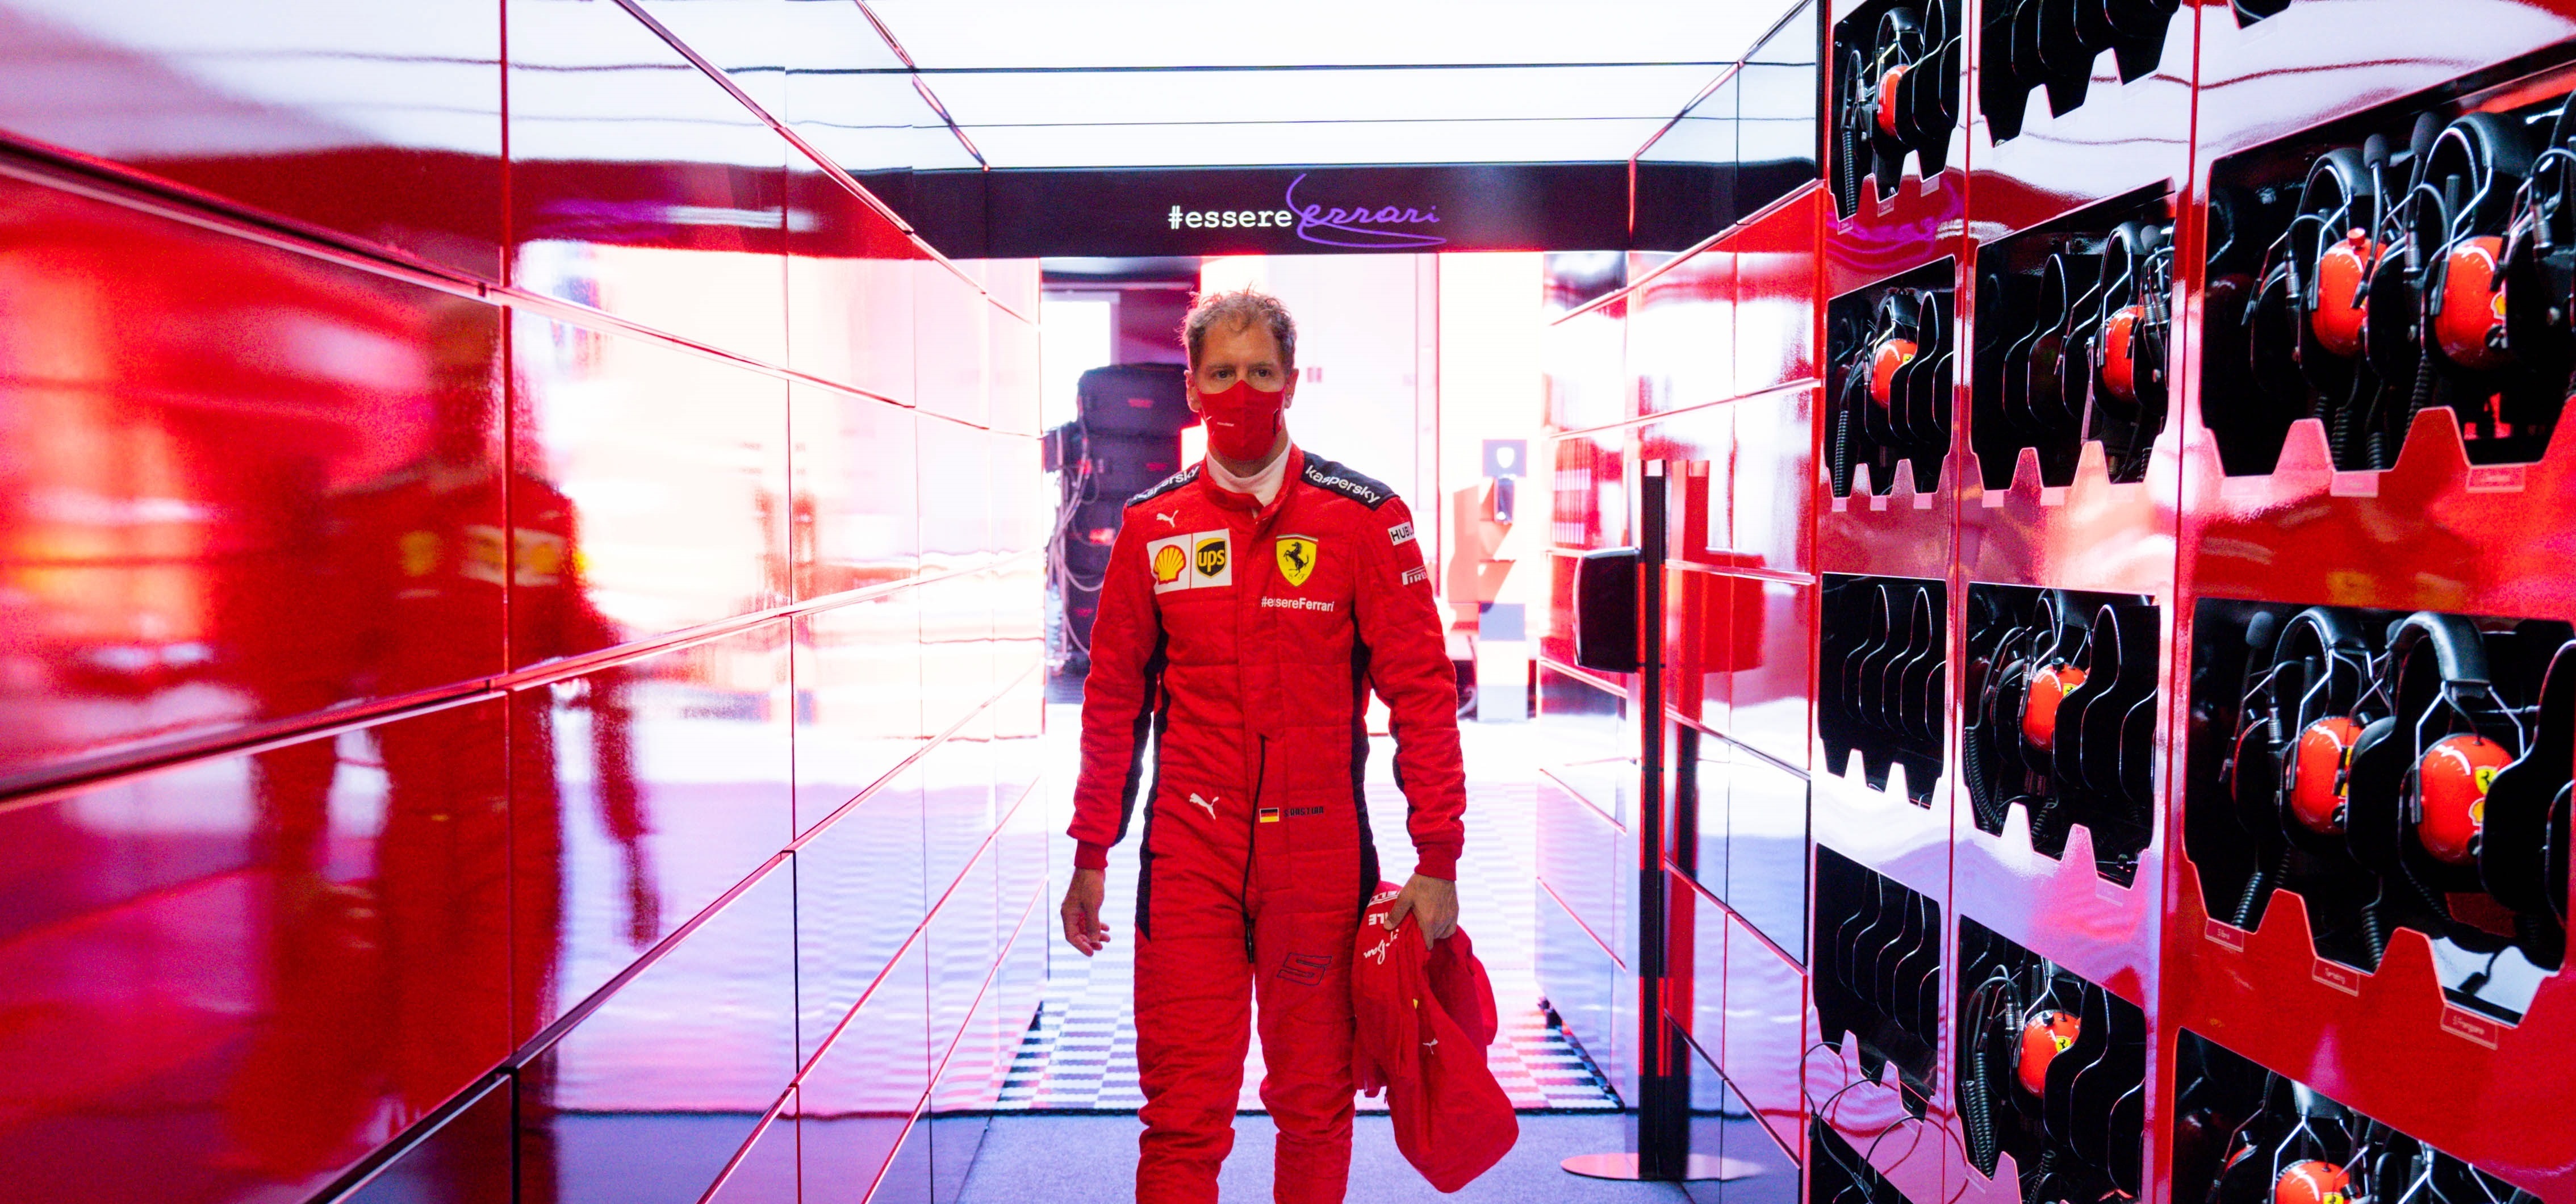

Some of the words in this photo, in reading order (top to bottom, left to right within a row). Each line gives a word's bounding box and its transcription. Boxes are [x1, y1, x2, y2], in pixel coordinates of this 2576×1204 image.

[1305, 465, 1381, 504] kaspersky
[1390, 526, 1414, 541] HUB
[1198, 549, 1226, 572] ups
[1401, 565, 1427, 586] PIRE
[1261, 596, 1335, 612] #esereFerrari
